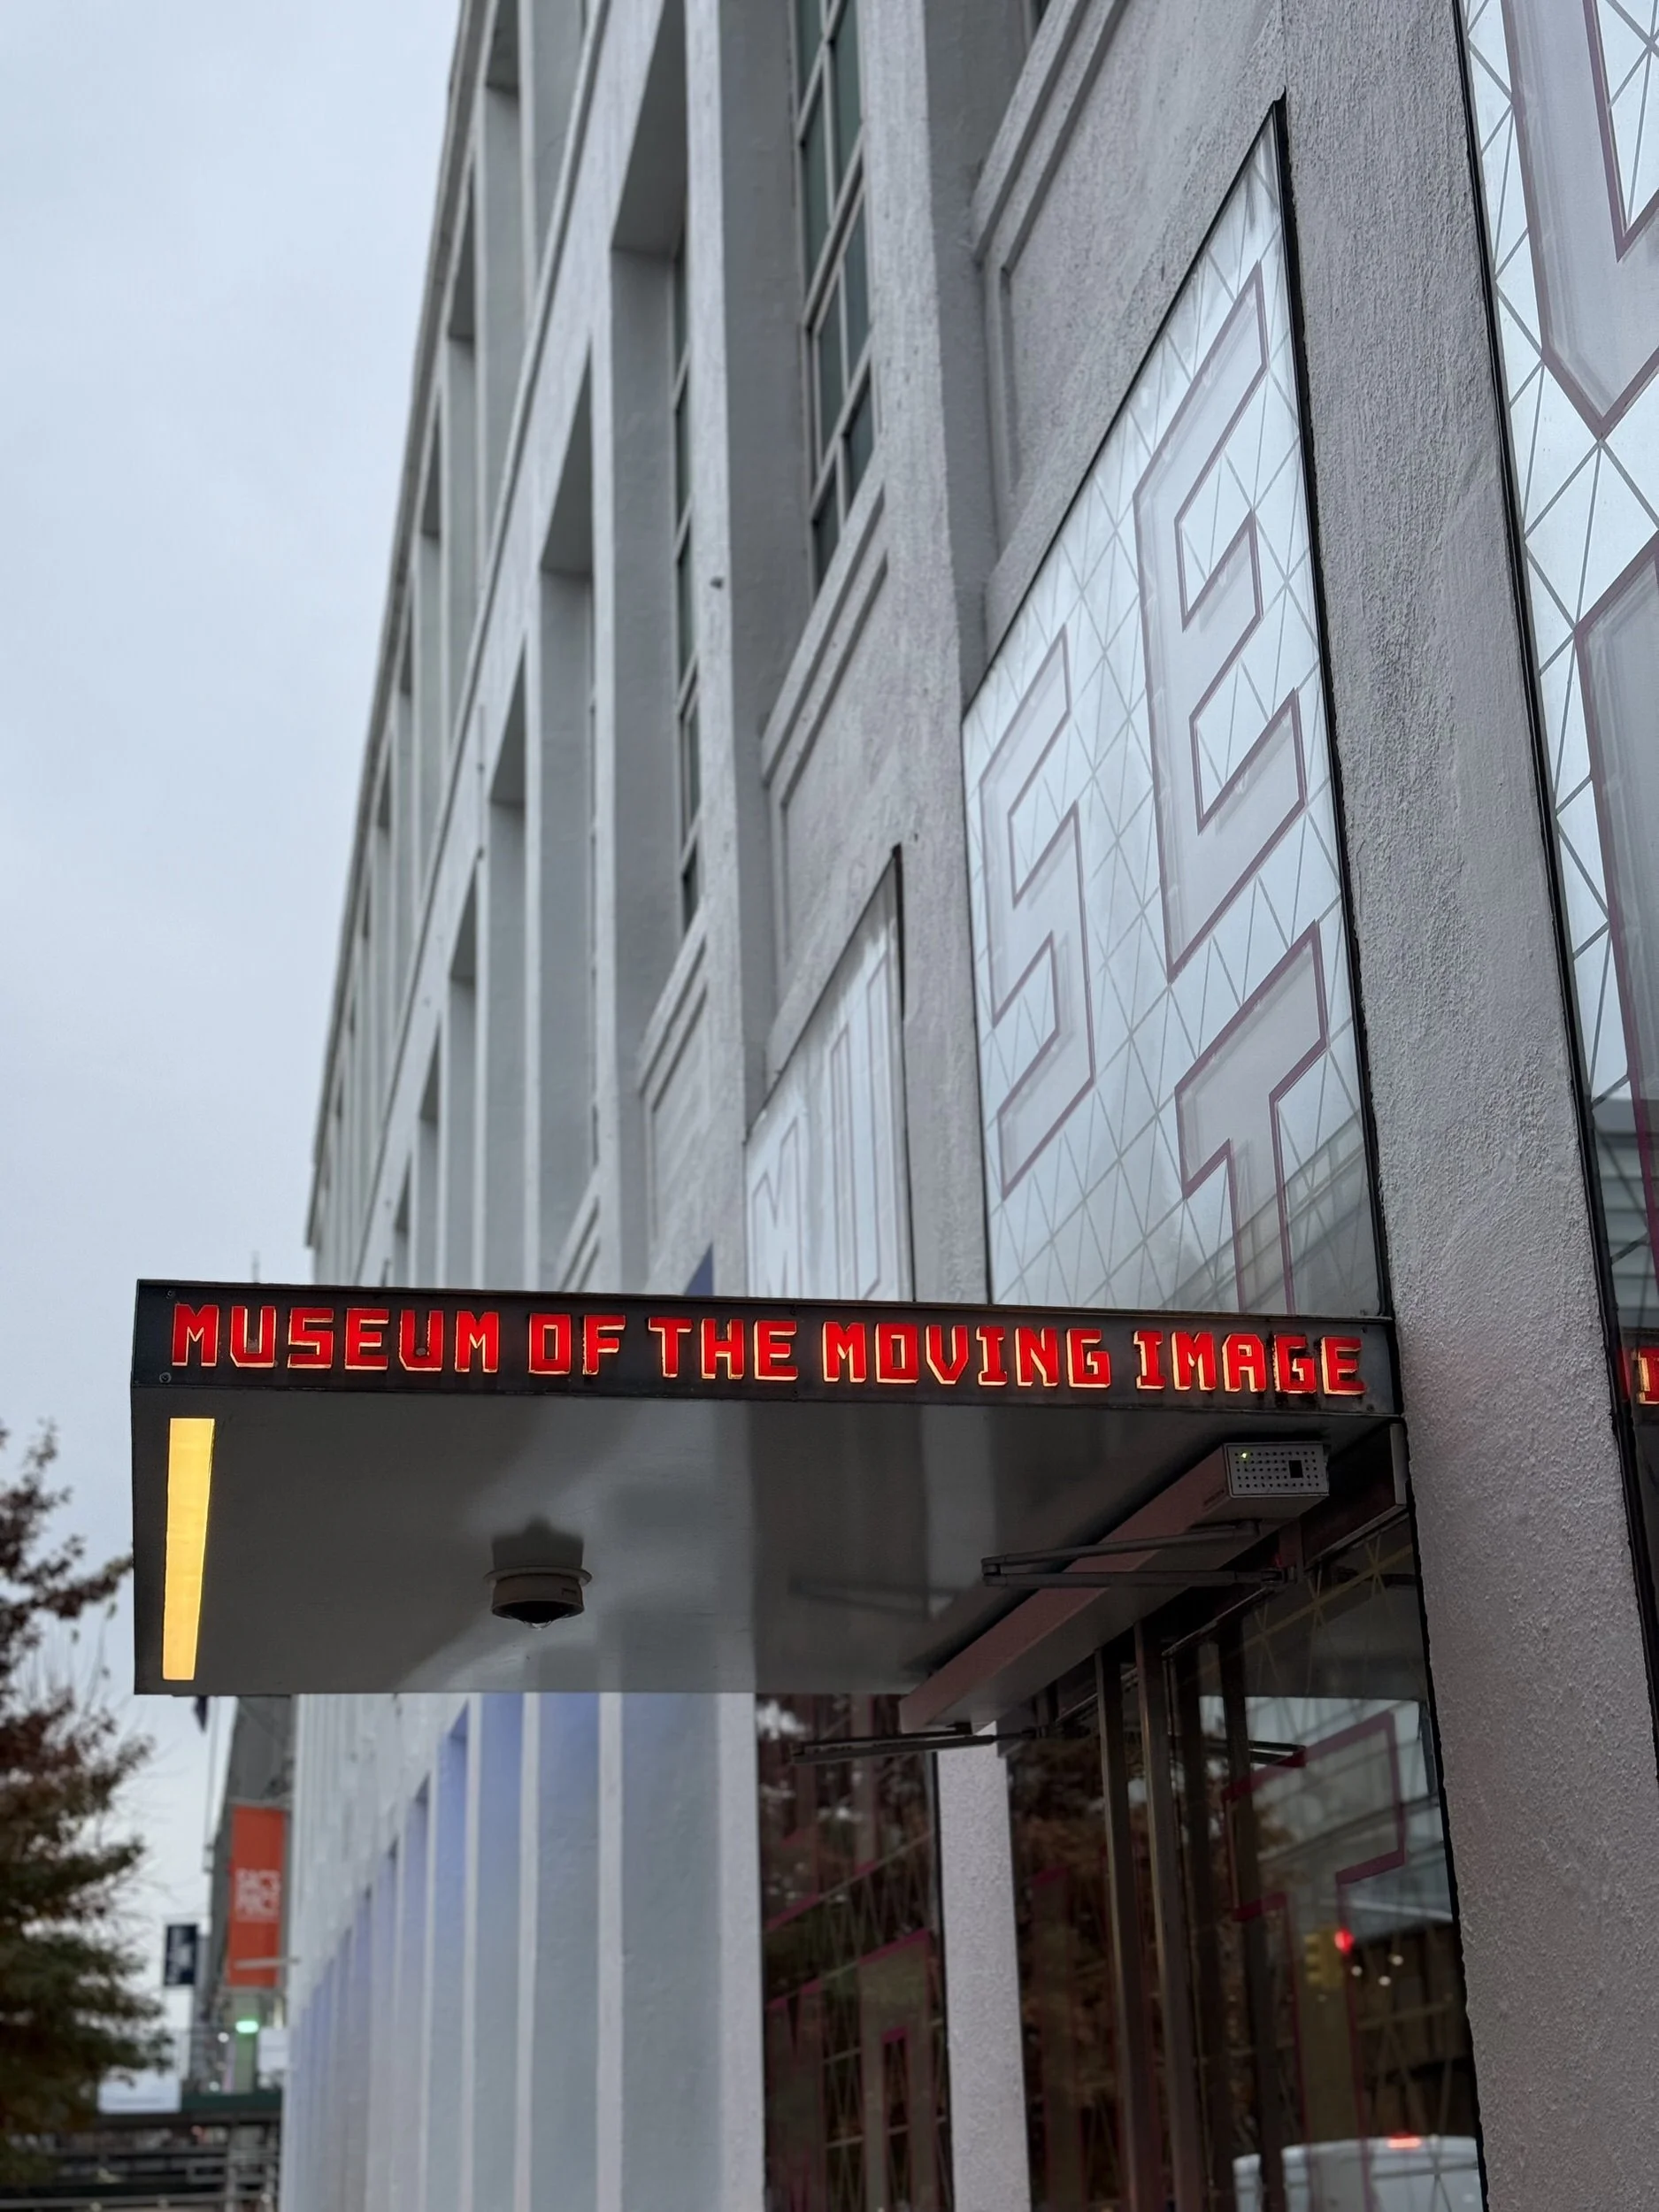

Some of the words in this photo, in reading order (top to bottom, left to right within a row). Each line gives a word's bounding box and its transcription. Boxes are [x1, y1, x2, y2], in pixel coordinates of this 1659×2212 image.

[172, 1303, 500, 1373] MUSEUM
[528, 1313, 626, 1376] OF
[648, 1317, 799, 1381] THE
[822, 1321, 1112, 1388] MOVING
[1133, 1330, 1365, 1395] IMAGE
